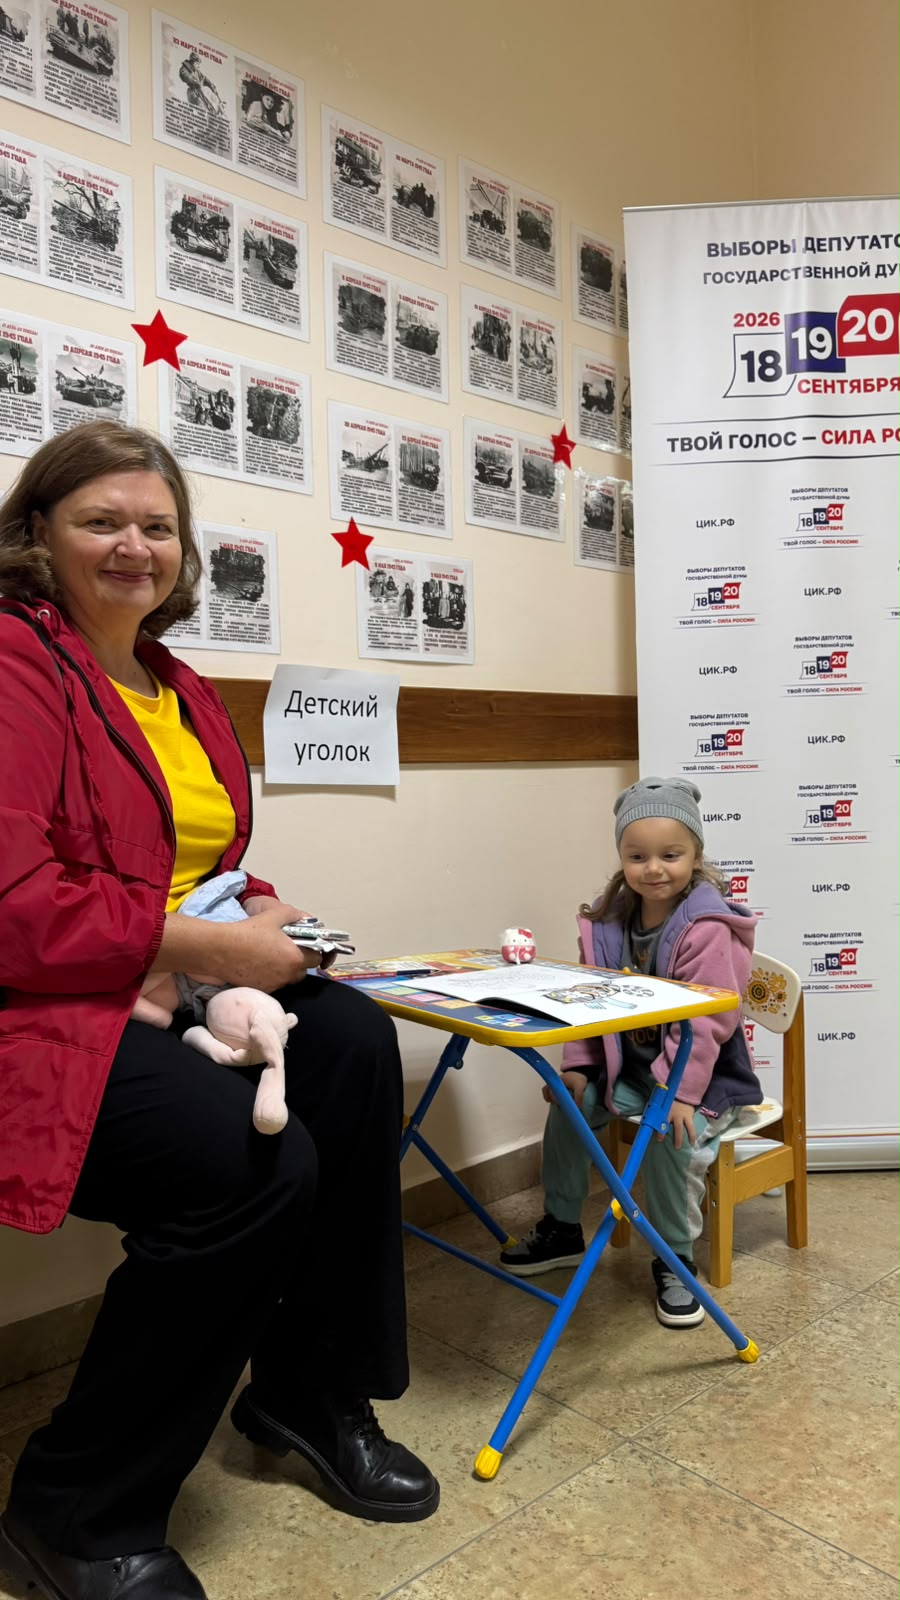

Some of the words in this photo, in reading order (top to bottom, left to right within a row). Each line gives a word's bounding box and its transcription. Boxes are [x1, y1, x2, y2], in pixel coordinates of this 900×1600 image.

[706, 239, 797, 257] ВЫБОРЫ
[703, 261, 870, 284] ГОСУДАРСТВЕННОЙ
[875, 263, 900, 278] ДУ
[733, 312, 780, 327] 2026
[17, 334, 33, 344] ГОДА
[740, 350, 782, 383] 18
[792, 327, 833, 360] 19
[842, 308, 895, 343] 20
[797, 377, 900, 394] СЕНТЯБРЯ
[667, 432, 722, 452] ТВОЙ
[729, 431, 796, 449] ГОЛОС
[821, 429, 876, 445] СИЛА
[696, 518, 735, 529] ЦИК.РФ
[801, 518, 812, 527] 18
[815, 512, 826, 521] 19
[828, 507, 841, 517] 20
[696, 597, 708, 607] 18
[710, 592, 721, 601] 19
[724, 586, 737, 596] 20
[804, 587, 842, 597] ЦИК.РФ
[699, 666, 737, 675] ЦИК.РФ
[804, 666, 816, 675] 18
[818, 660, 830, 670] 19
[831, 655, 845, 665] 20
[284, 690, 378, 719] Детский
[699, 743, 711, 753] 18
[713, 738, 724, 748] 19
[727, 733, 741, 743] 20
[808, 735, 845, 744] ЦИК.РФ
[294, 743, 370, 765] уголок
[703, 813, 741, 823] ЦИК.РФ
[808, 814, 820, 824] 18
[821, 809, 834, 818] 19
[835, 804, 849, 813] 20
[731, 880, 746, 889] 20
[812, 883, 850, 893] ЦИК.РФ
[813, 963, 825, 972] 18
[827, 957, 838, 966] 19
[841, 952, 854, 961] 20
[818, 1032, 856, 1041] ЦИК.РФ
